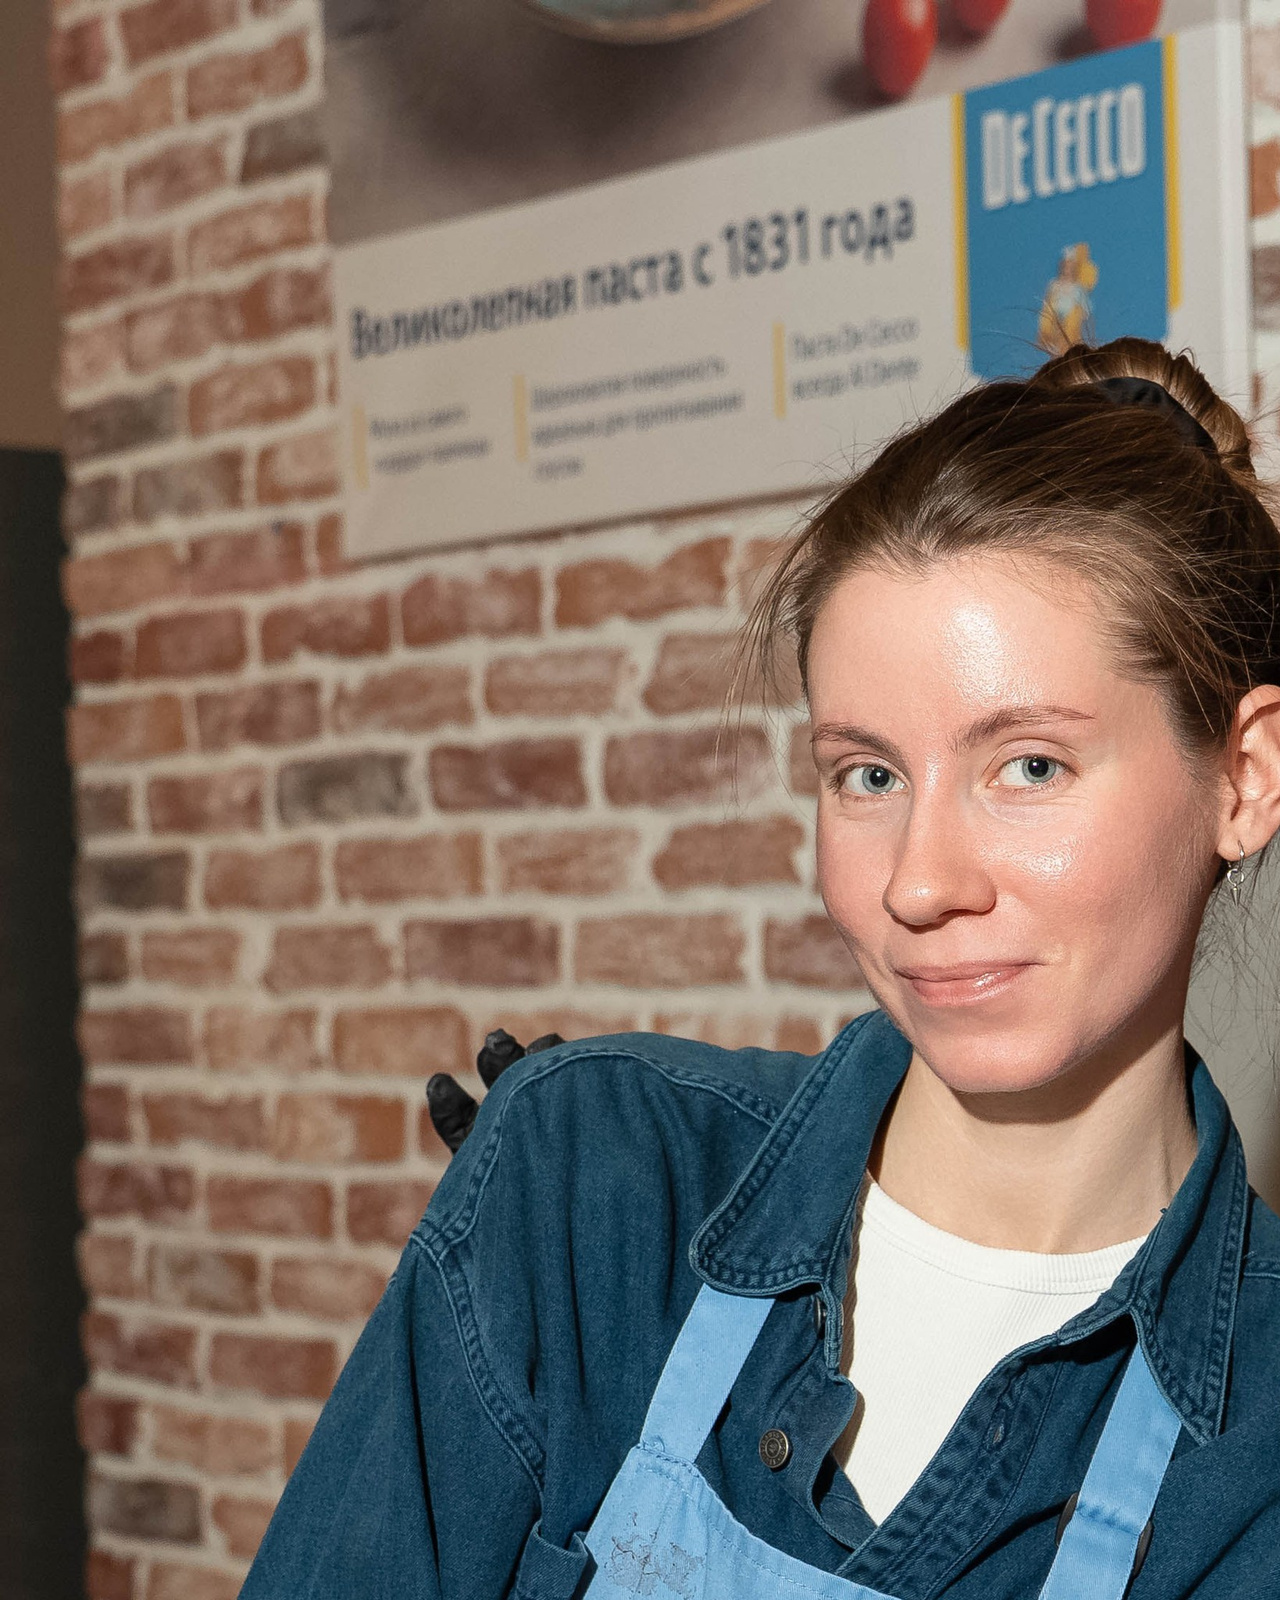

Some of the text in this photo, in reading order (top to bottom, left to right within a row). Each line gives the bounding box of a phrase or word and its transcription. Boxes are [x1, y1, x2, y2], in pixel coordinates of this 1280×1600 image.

[351, 195, 916, 361] Великолепная паста с 1831 года
